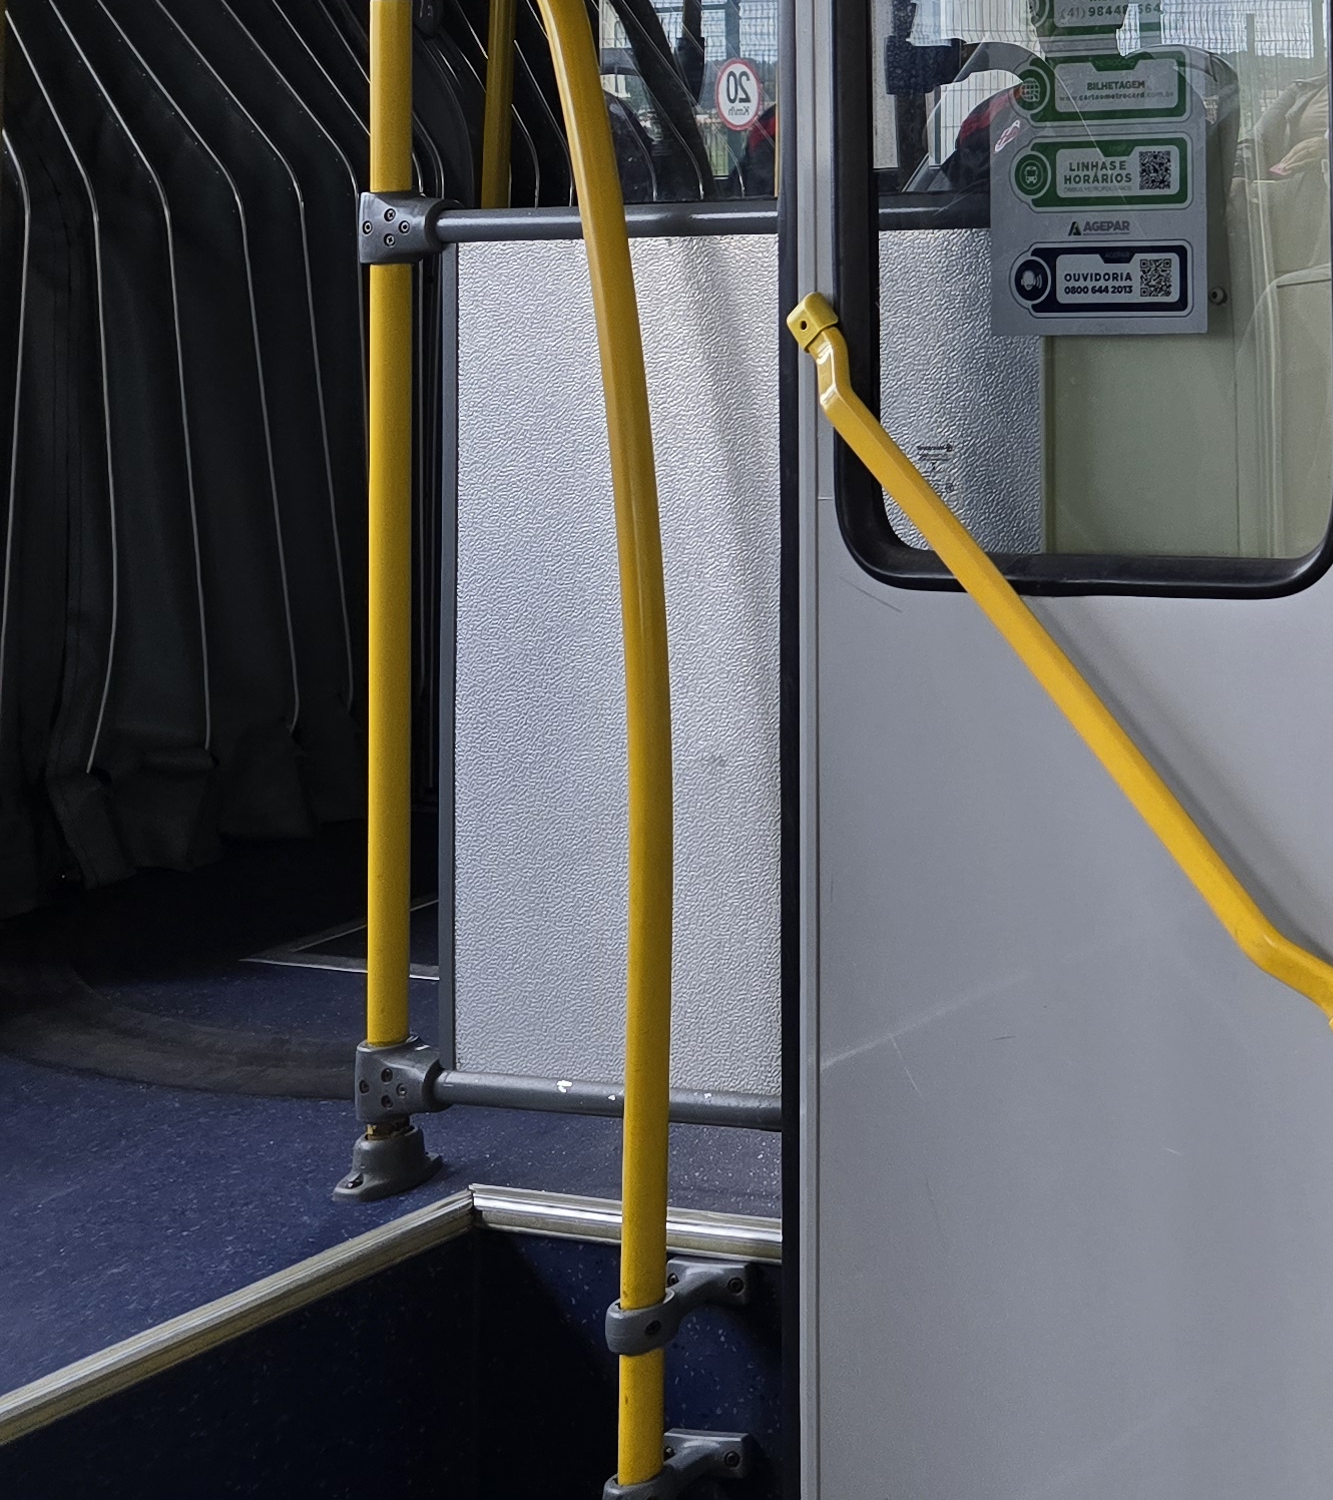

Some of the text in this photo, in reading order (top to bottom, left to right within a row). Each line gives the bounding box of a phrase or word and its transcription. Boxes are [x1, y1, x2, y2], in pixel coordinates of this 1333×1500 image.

[1086, 79, 1146, 91] BILHETAGEM
[1069, 160, 1118, 173] LINHAS
[1063, 171, 1133, 185] HORÁRIOS
[1083, 220, 1131, 232] AGEPAR
[1063, 272, 1133, 283] OUVIDORIA
[1063, 284, 1133, 295] 0800 644 2013
